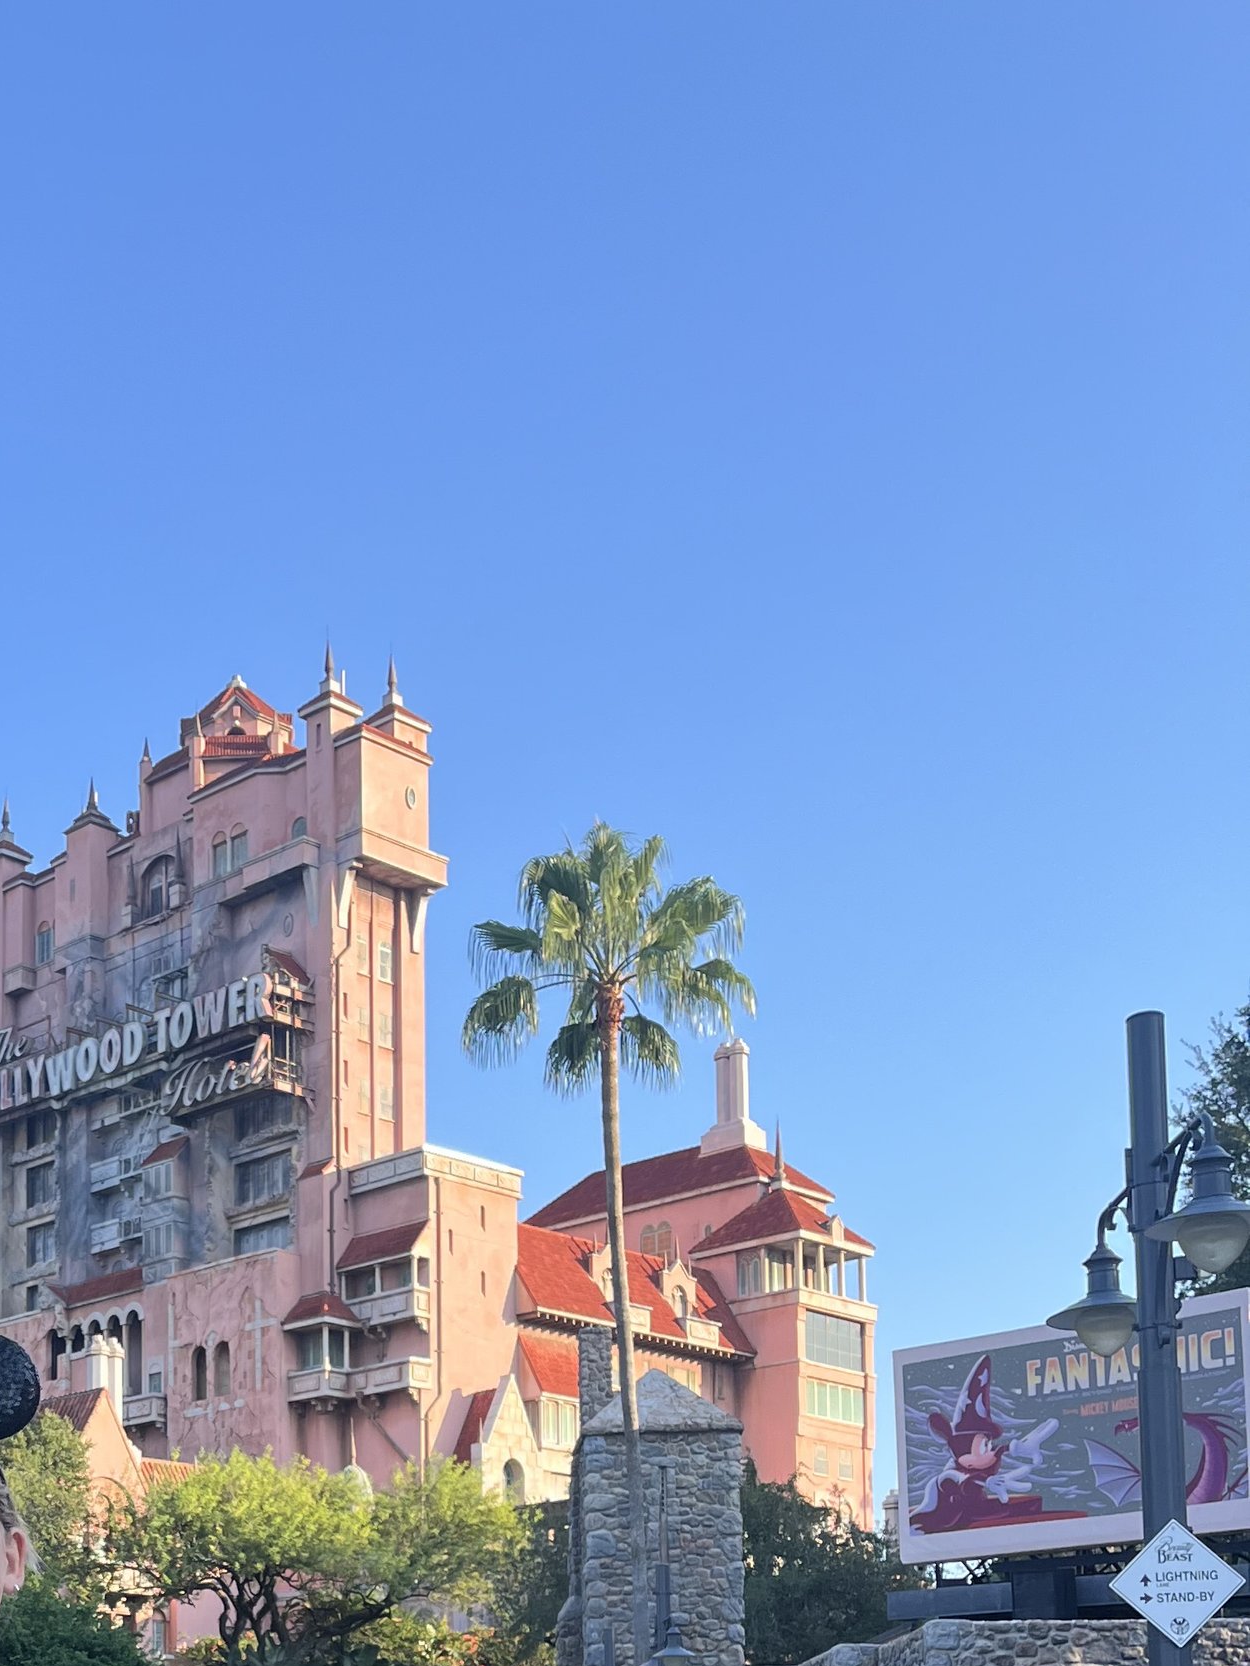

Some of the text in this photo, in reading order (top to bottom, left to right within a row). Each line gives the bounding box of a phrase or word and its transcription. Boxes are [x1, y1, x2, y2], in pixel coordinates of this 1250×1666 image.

[150, 971, 274, 1055] TOWER
[159, 1032, 272, 1116] Hotel
[1157, 1549, 1194, 1564] BEAST
[1155, 1570, 1219, 1582] LIGHTNING
[1156, 1591, 1215, 1603] STAND-BY
